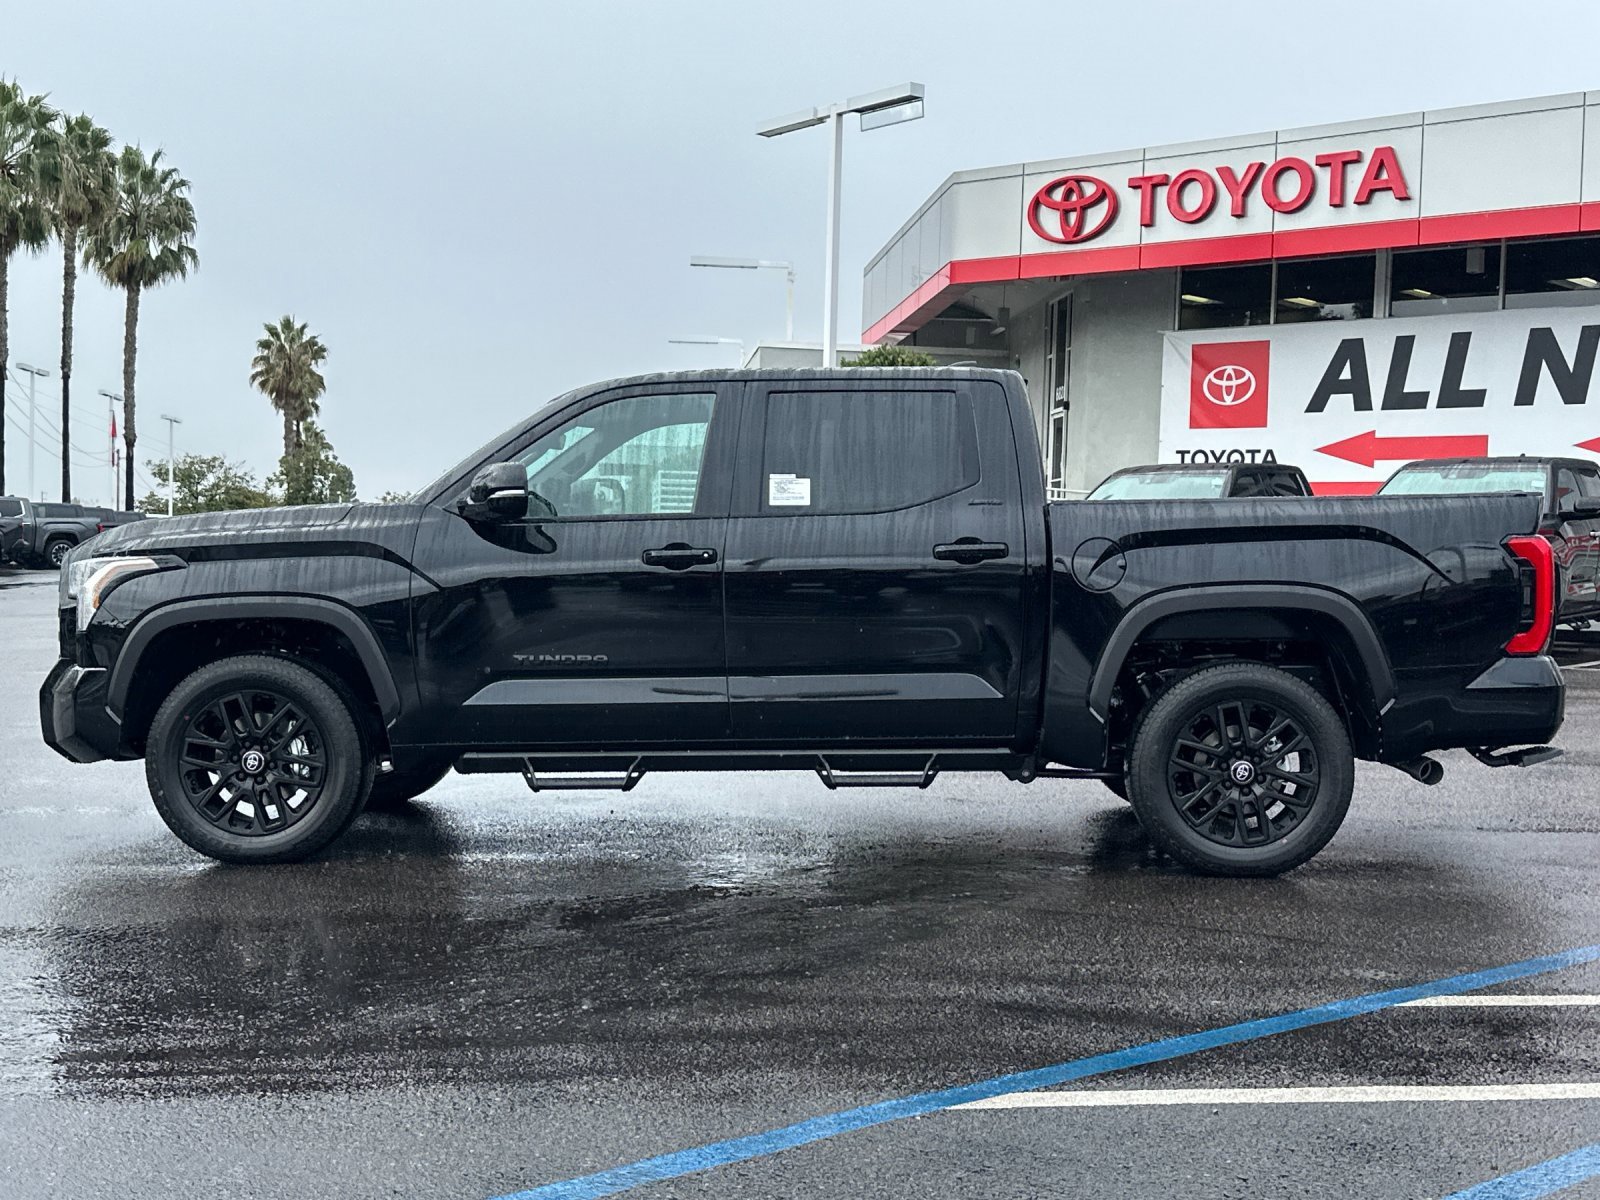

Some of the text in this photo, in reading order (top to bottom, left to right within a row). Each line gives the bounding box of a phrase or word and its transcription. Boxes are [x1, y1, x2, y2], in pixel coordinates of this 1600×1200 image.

[1128, 145, 1411, 228] TOYOTA
[1304, 331, 1487, 413] ALL
[1175, 449, 1278, 464] TOYOTA
